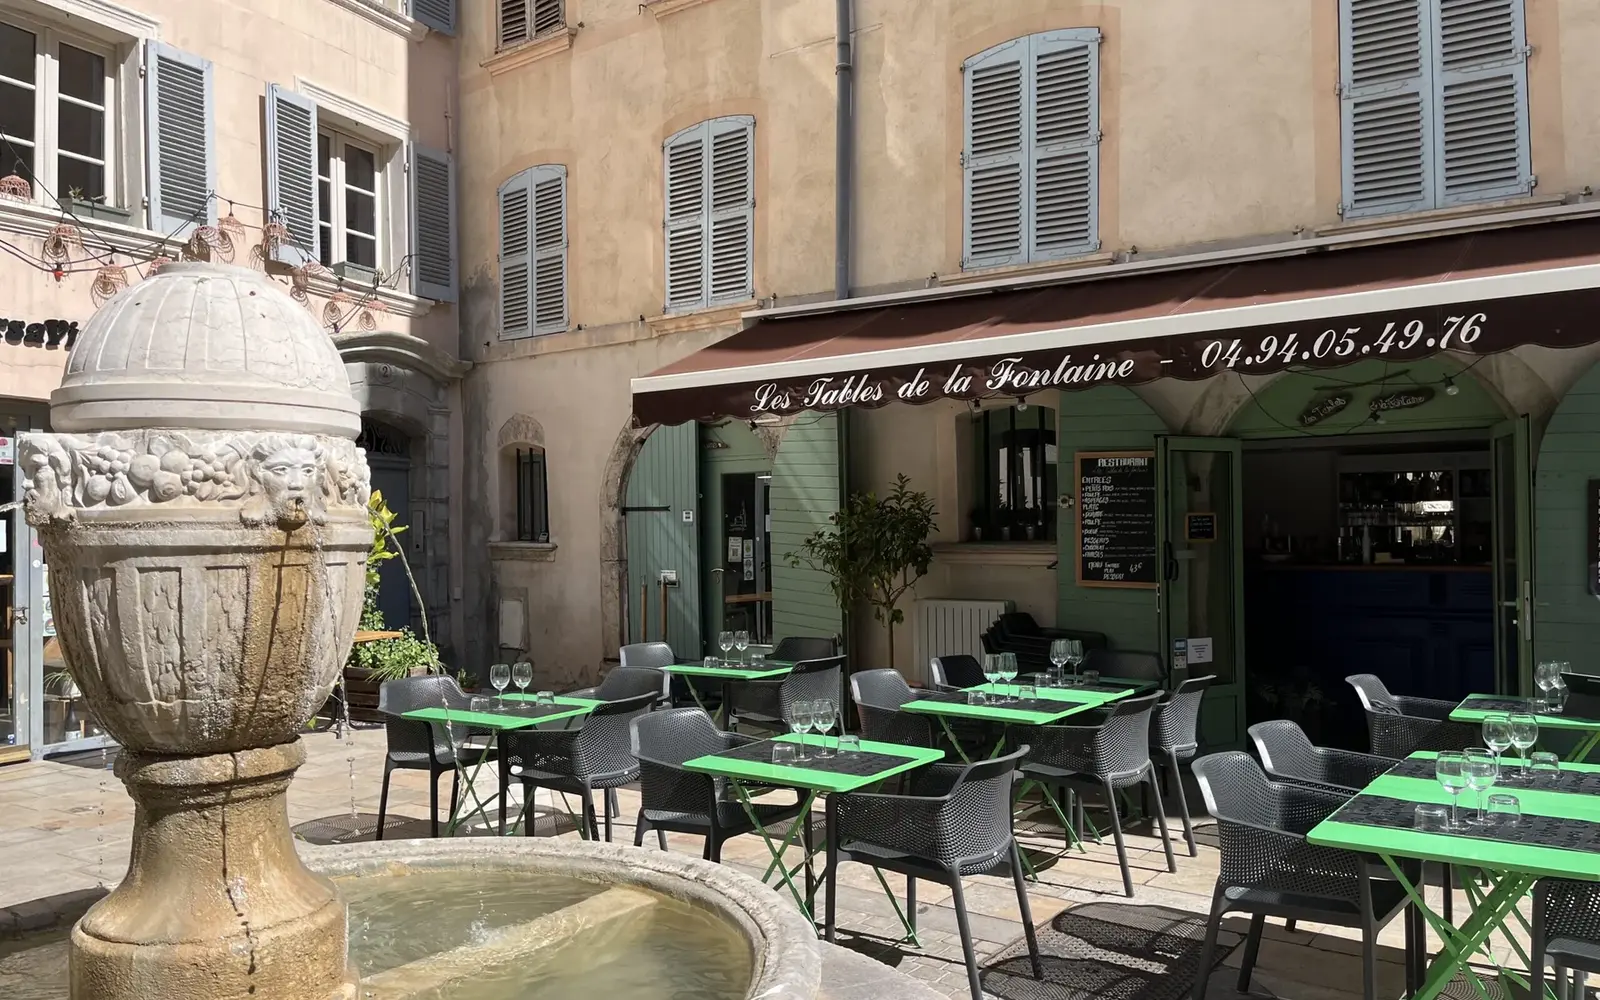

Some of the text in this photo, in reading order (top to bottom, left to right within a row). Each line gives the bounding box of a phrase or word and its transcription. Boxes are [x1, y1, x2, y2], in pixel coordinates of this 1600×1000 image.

[1200, 312, 1488, 369] 04.94.05.49.76
[381, 365, 390, 379] 2
[749, 382, 791, 412] Les
[803, 373, 884, 407] Tables
[897, 367, 930, 399] de
[942, 363, 973, 394] la
[985, 354, 1135, 390] Fontaine
[1097, 457, 1149, 467] RESTAURANT
